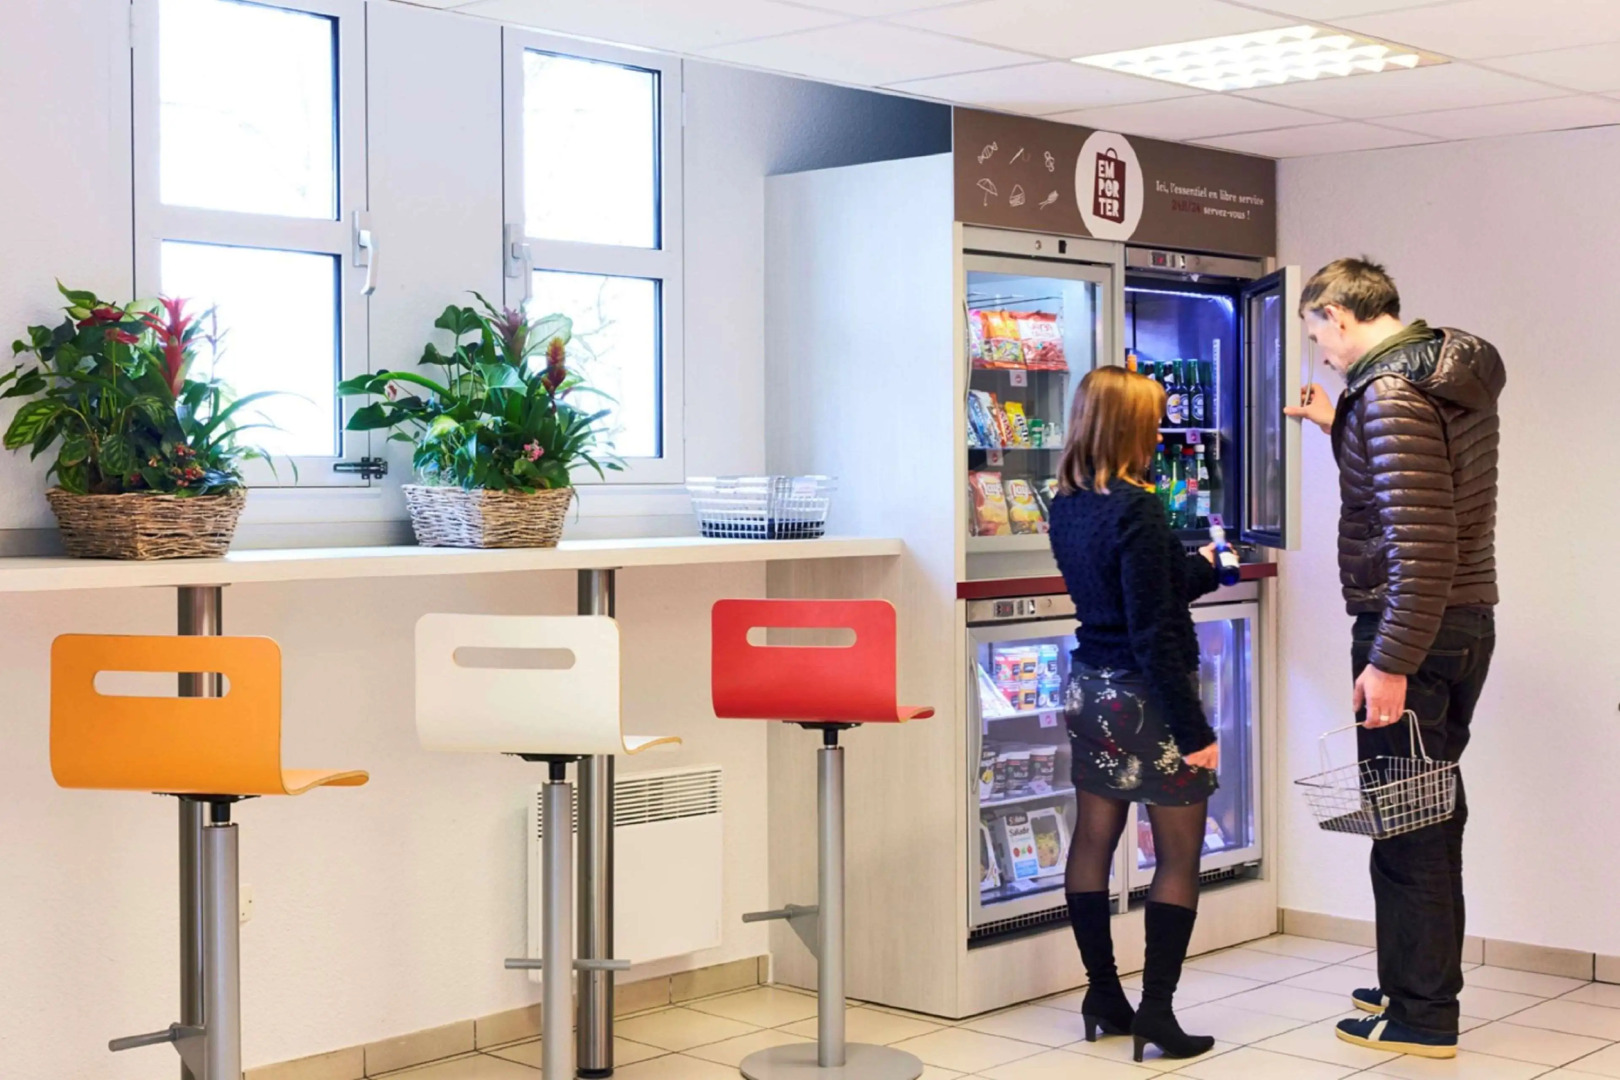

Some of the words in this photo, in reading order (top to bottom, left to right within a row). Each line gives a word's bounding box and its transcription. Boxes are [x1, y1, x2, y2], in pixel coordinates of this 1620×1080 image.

[1098, 160, 1115, 179] EM
[1098, 178, 1119, 198] POR
[1170, 182, 1207, 198] l'essentiel
[1208, 191, 1218, 199] en
[1220, 190, 1237, 202] libre
[1238, 194, 1264, 206] service
[1098, 197, 1119, 217] TER
[1204, 206, 1246, 220] servez-vous
